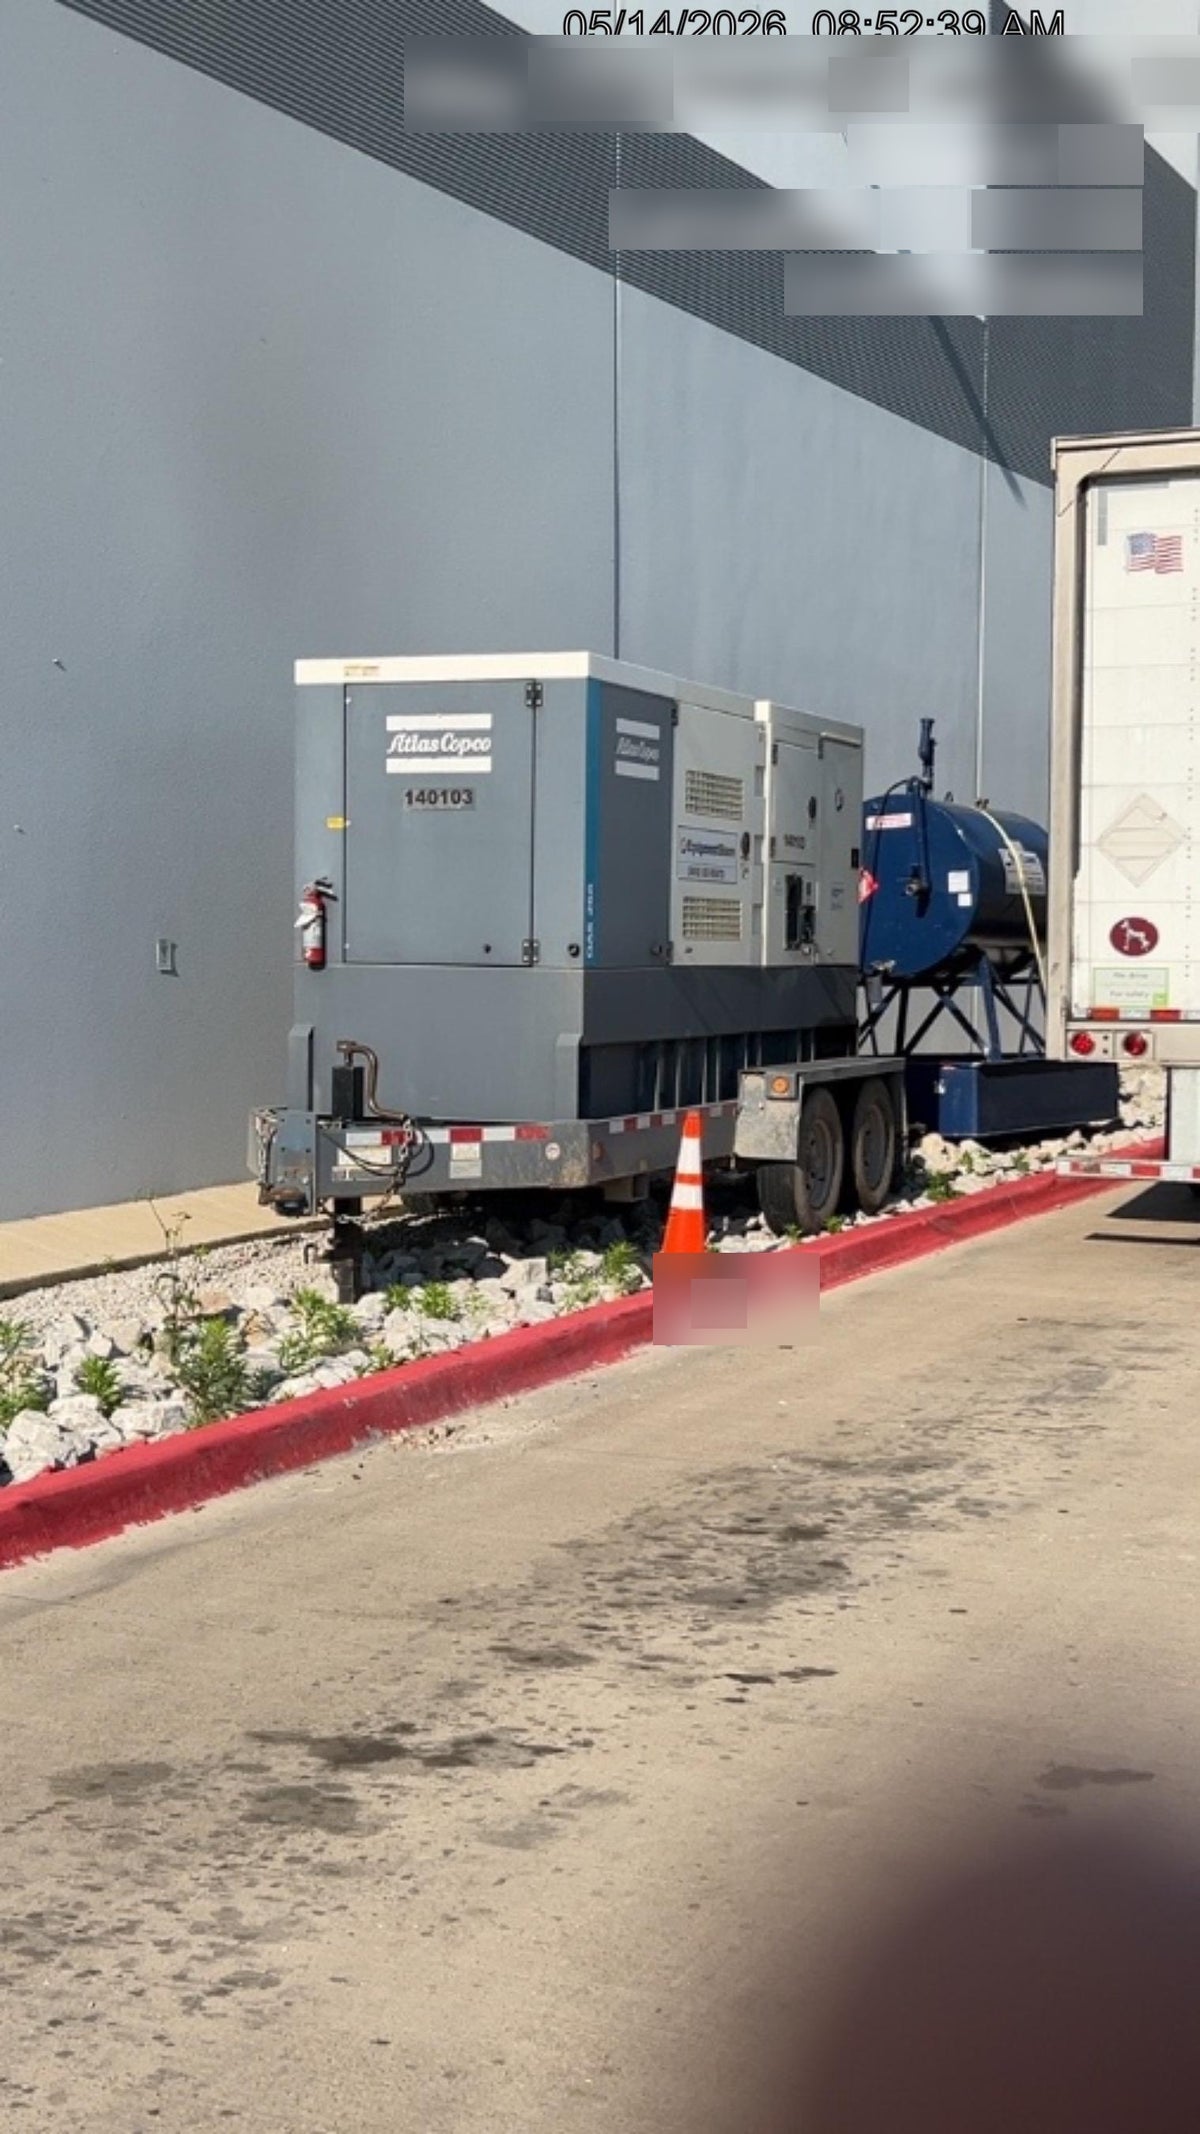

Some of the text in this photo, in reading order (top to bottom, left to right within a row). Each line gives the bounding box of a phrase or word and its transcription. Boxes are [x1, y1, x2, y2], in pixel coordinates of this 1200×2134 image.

[386, 732, 492, 757] Atlas Copco
[404, 788, 473, 806] 140103
